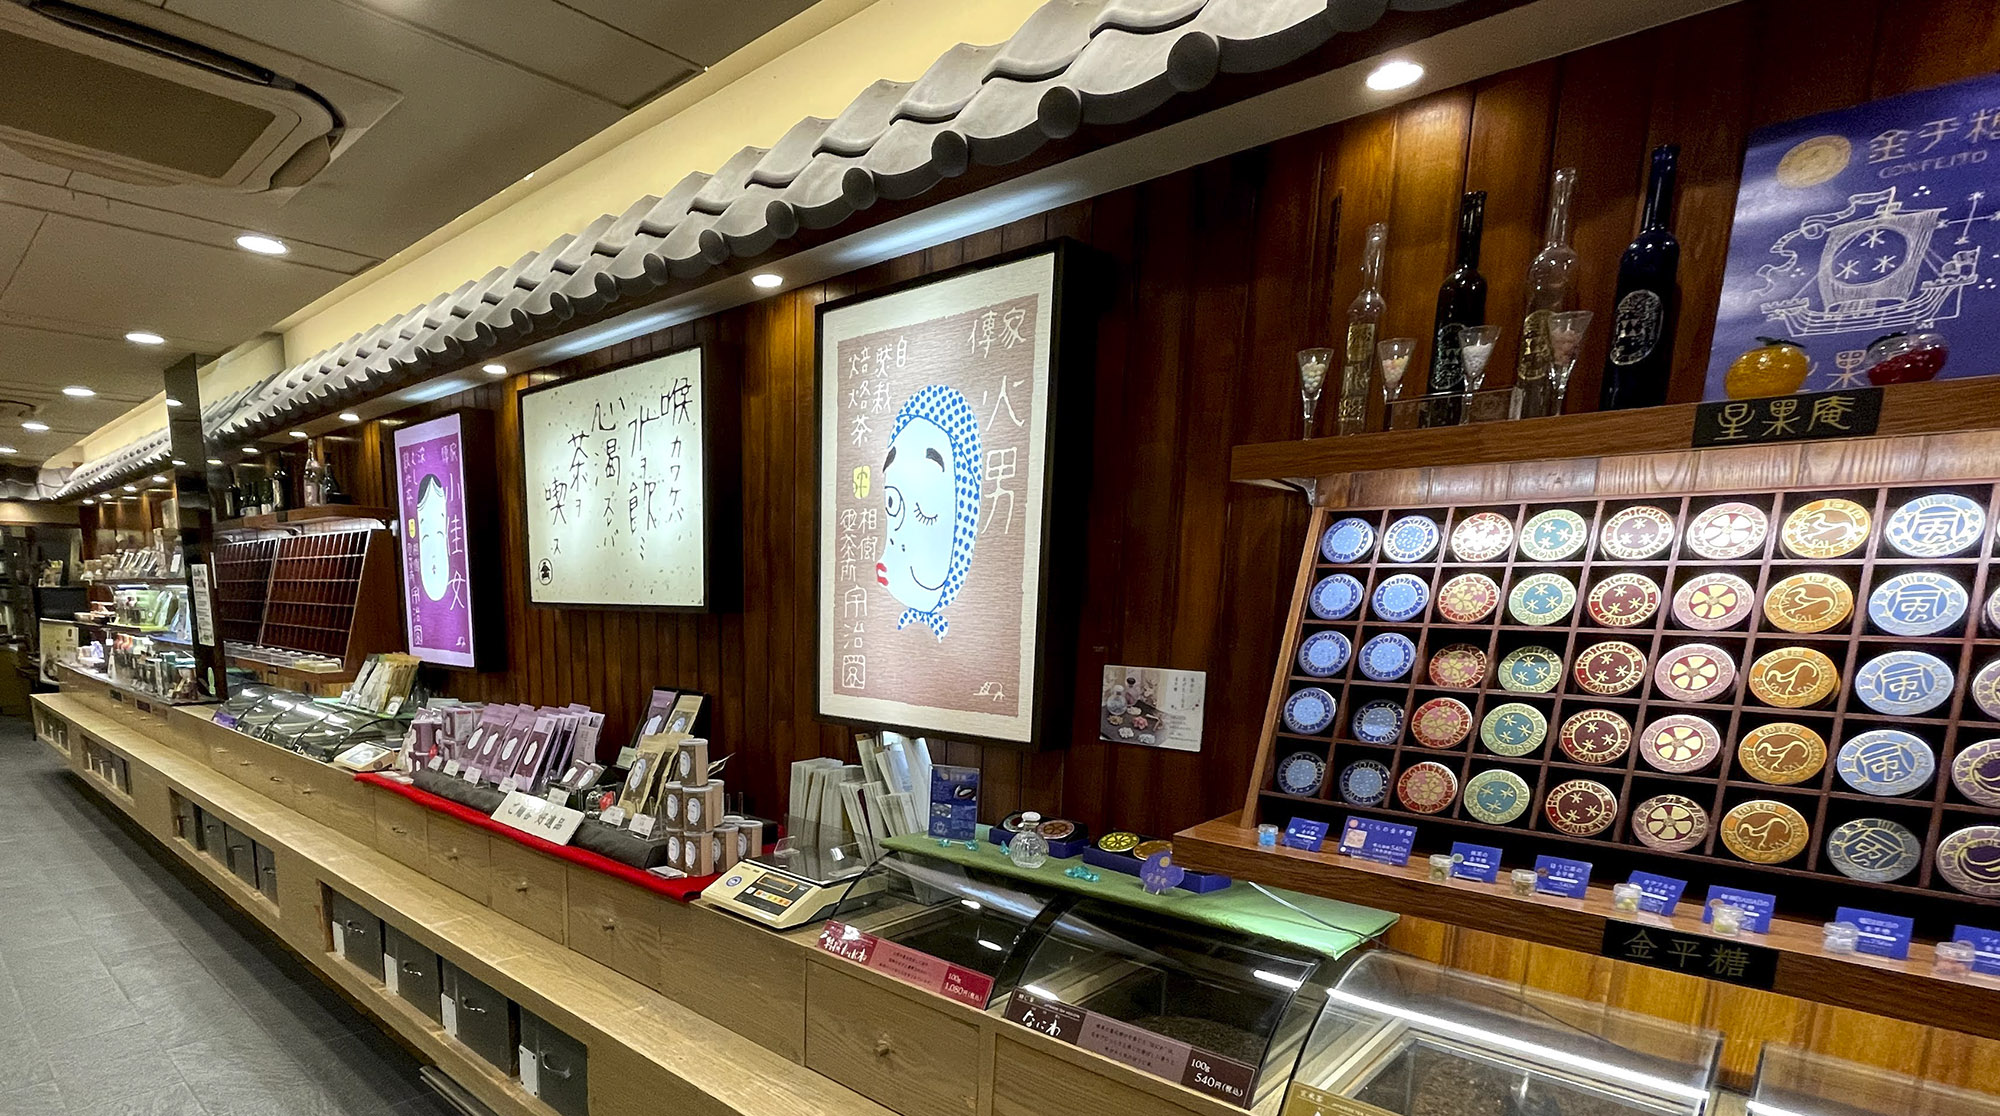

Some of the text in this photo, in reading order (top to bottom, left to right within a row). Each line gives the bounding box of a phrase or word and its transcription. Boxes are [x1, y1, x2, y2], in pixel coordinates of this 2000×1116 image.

[1624, 929, 1750, 976] 金平糖
[1022, 1009, 1062, 1037] なにわ
[1191, 1058, 1212, 1073] 100g
